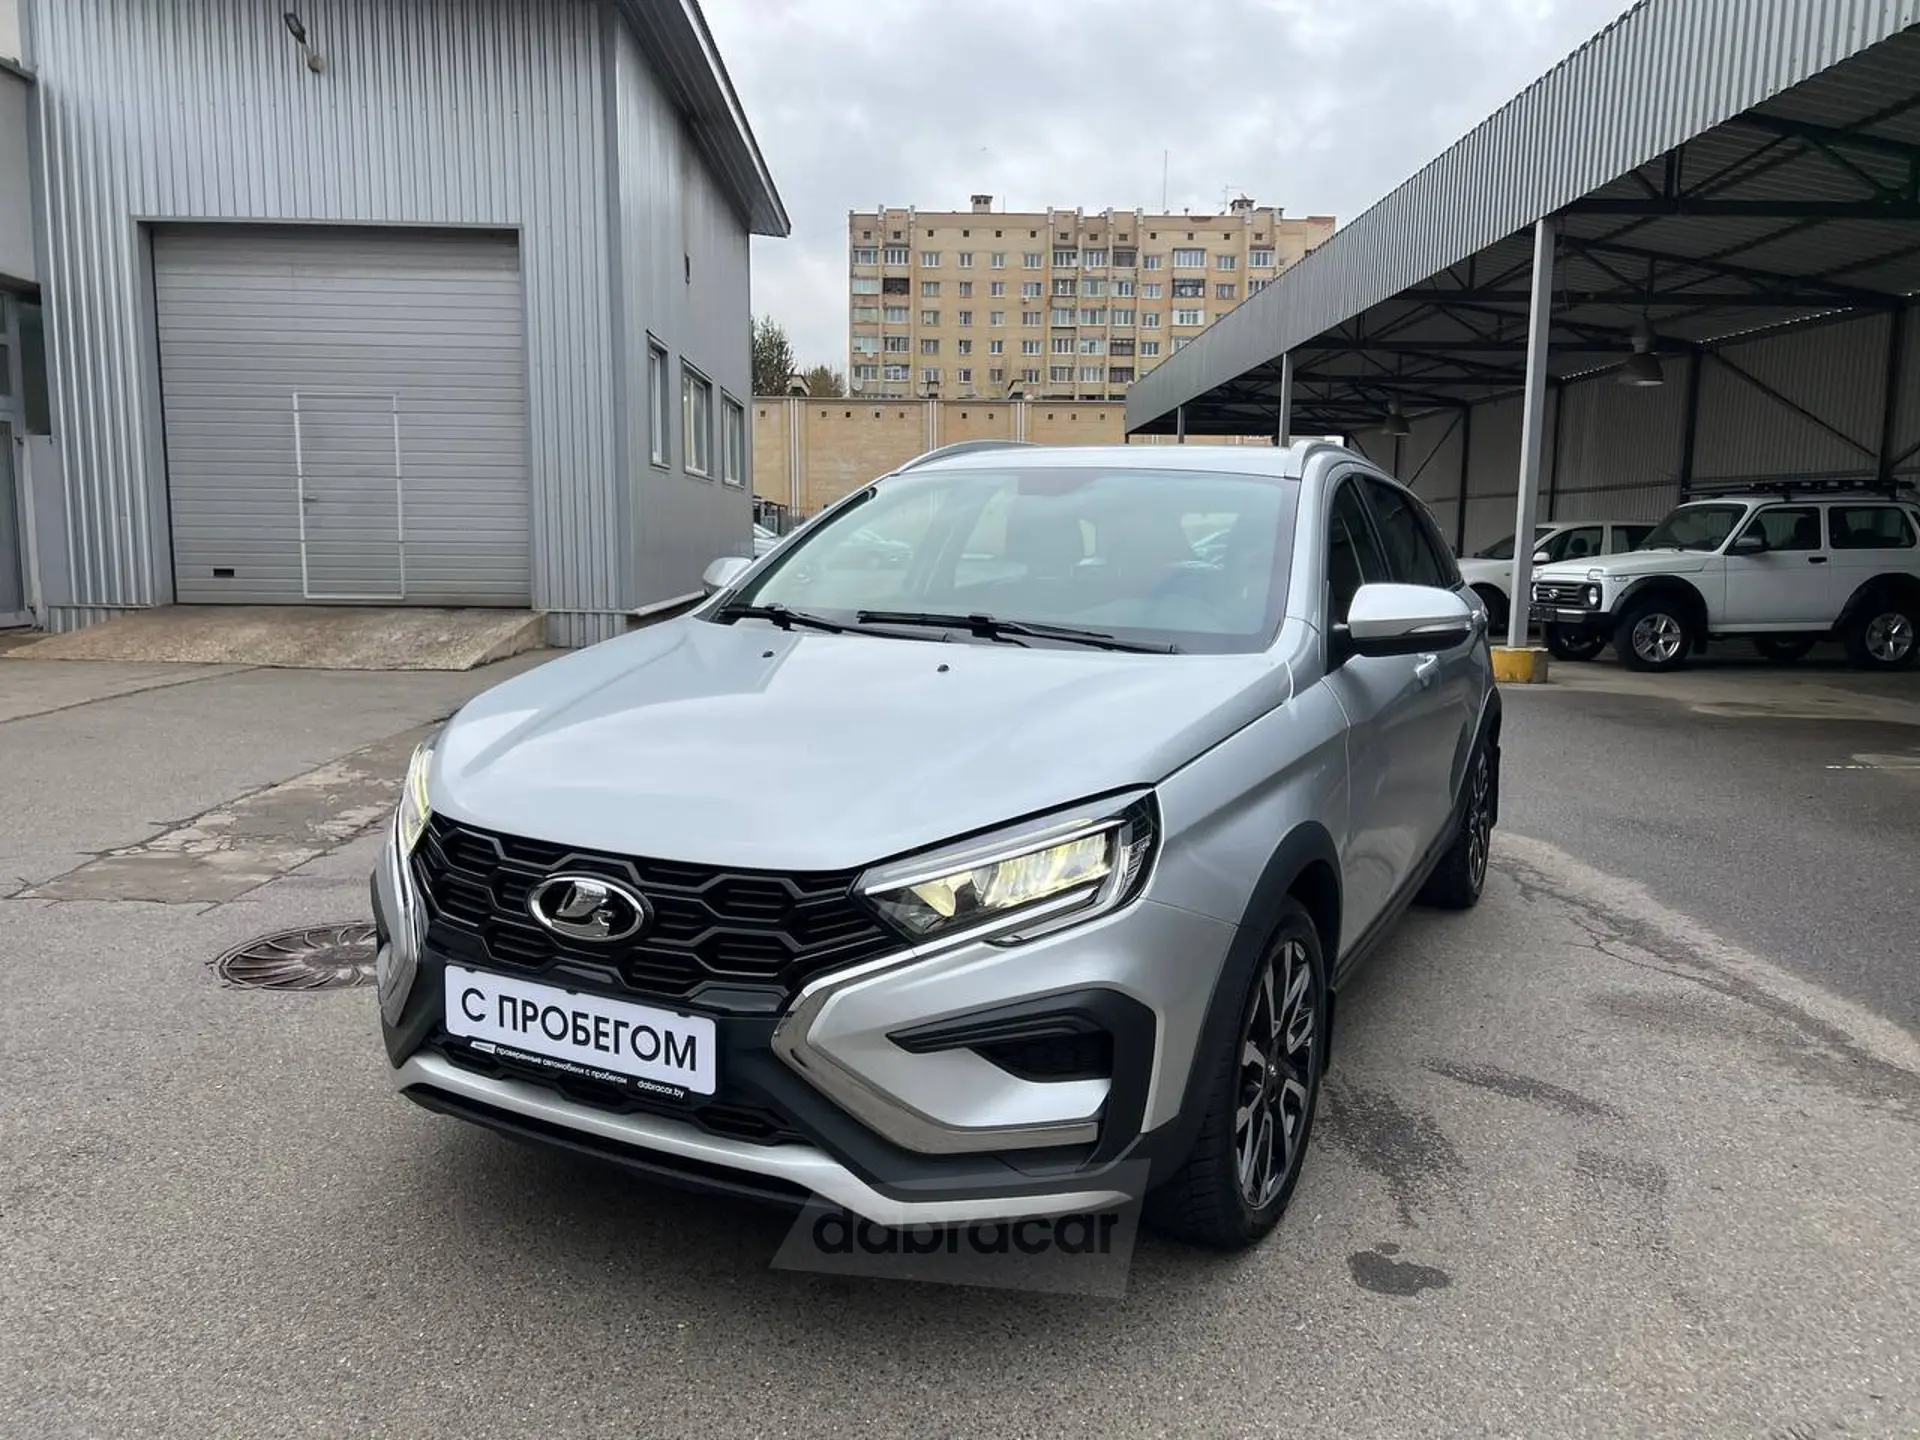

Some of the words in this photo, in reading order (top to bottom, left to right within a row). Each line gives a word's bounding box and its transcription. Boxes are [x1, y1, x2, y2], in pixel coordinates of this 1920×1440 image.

[461, 987, 487, 1022] С
[498, 993, 698, 1072] ПРОБЕГОМ
[542, 1058, 584, 1075] автомобили
[590, 1070, 628, 1085] пробегом
[636, 1079, 685, 1099] dabracar.by
